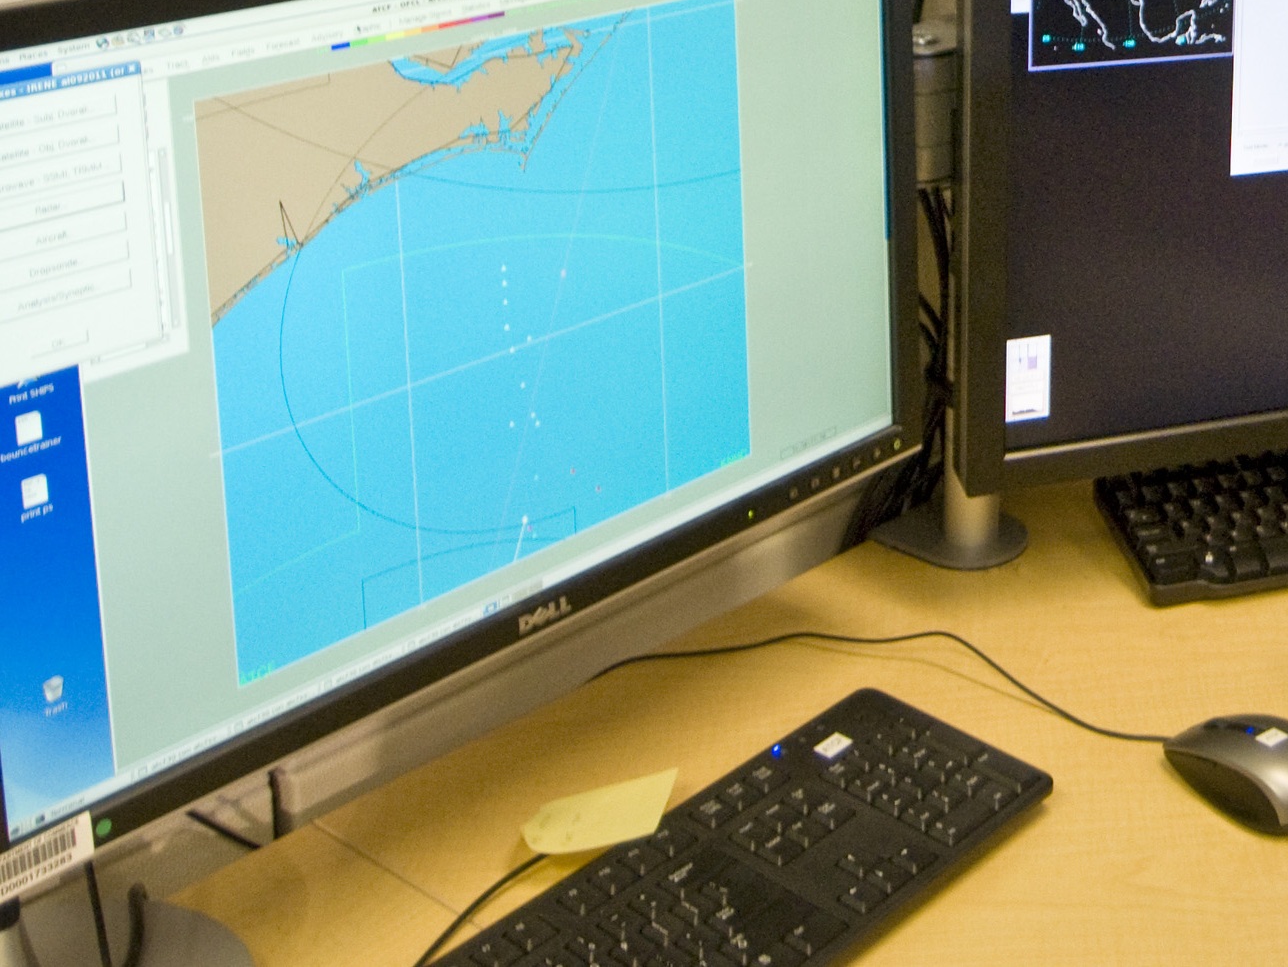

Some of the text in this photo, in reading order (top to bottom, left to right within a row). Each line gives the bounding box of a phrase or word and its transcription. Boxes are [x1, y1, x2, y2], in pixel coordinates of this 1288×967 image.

[26, 80, 58, 94] IRENE
[8, 391, 28, 406] Print
[518, 594, 573, 634] DELL
